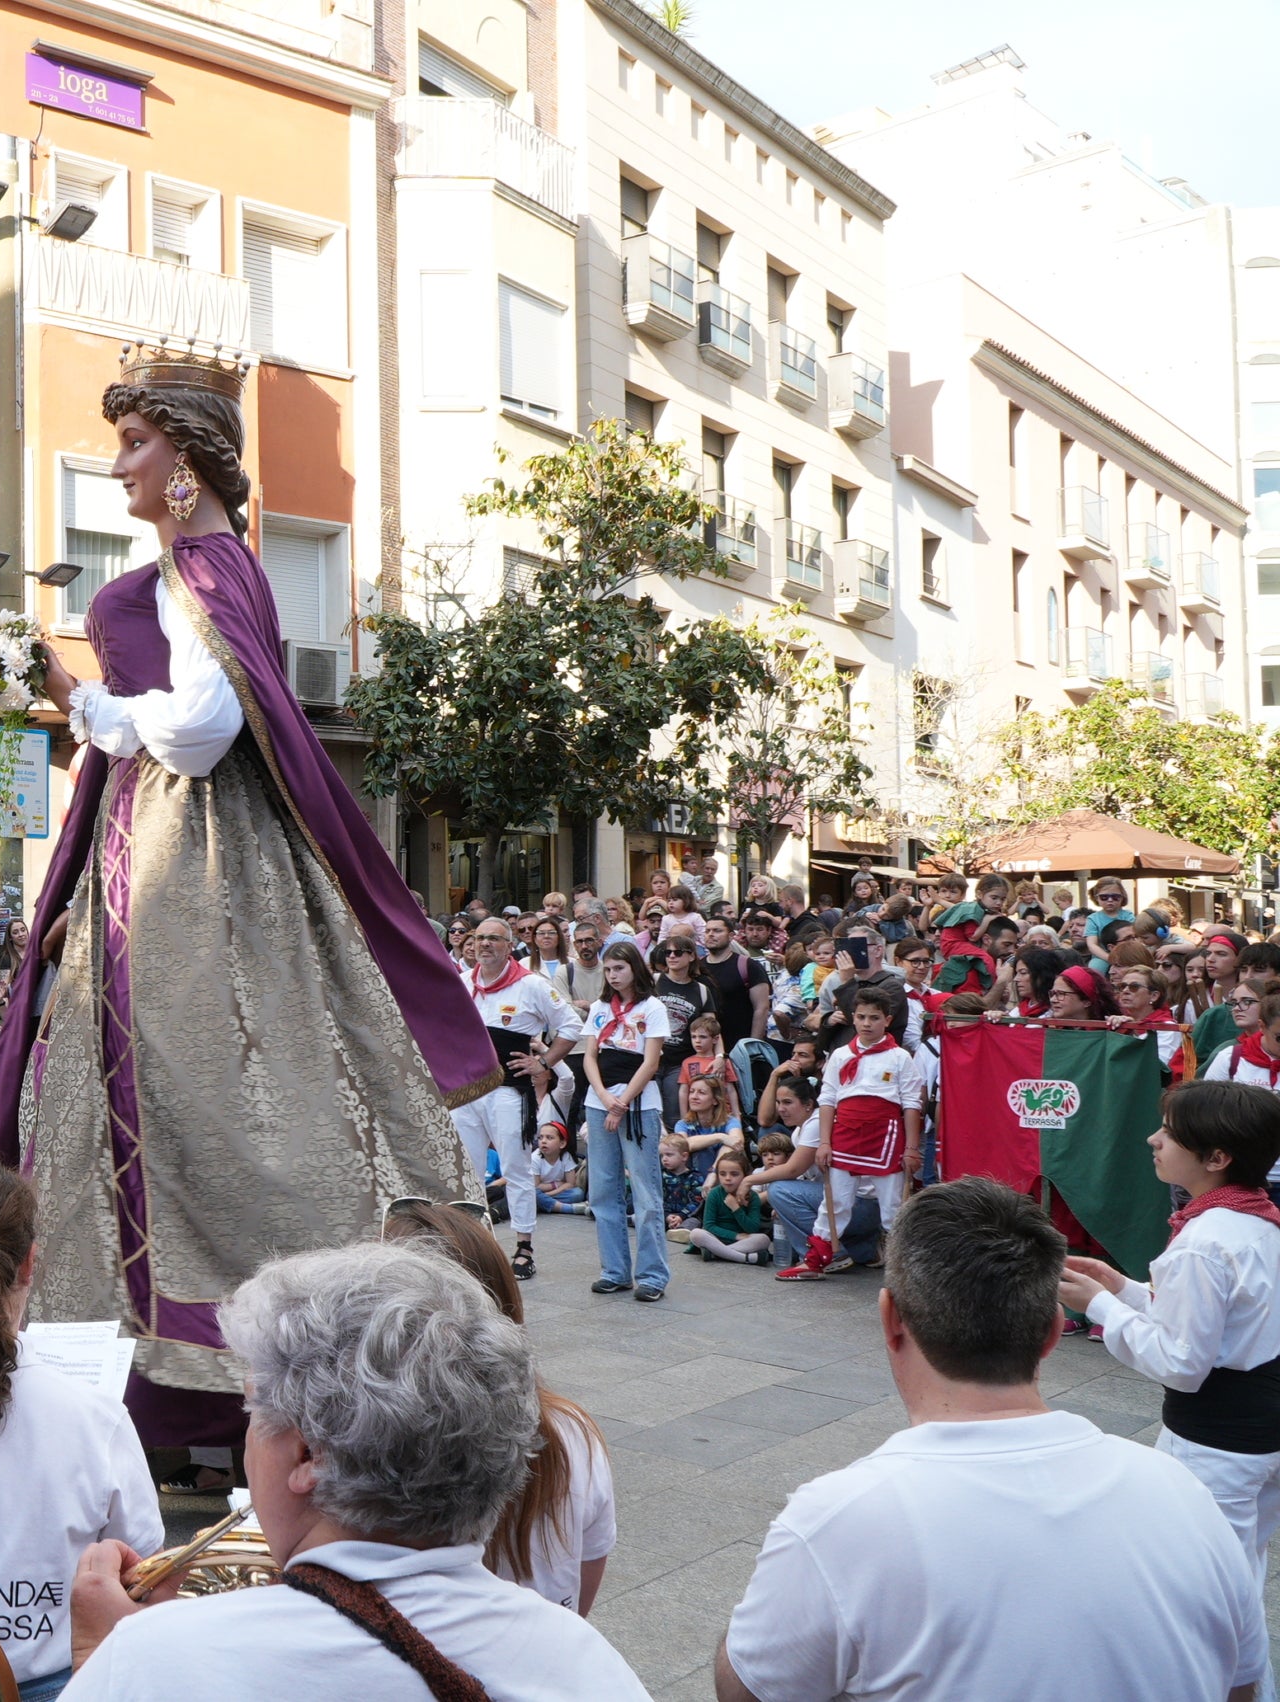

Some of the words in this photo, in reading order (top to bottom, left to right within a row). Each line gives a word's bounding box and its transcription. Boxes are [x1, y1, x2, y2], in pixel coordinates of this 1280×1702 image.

[58, 65, 108, 104] ioga
[95, 106, 108, 117] 601
[109, 112, 117, 120] 41
[117, 113, 126, 123] 75
[126, 116, 136, 126] 95
[1024, 1117, 1062, 1127] TERRASSA
